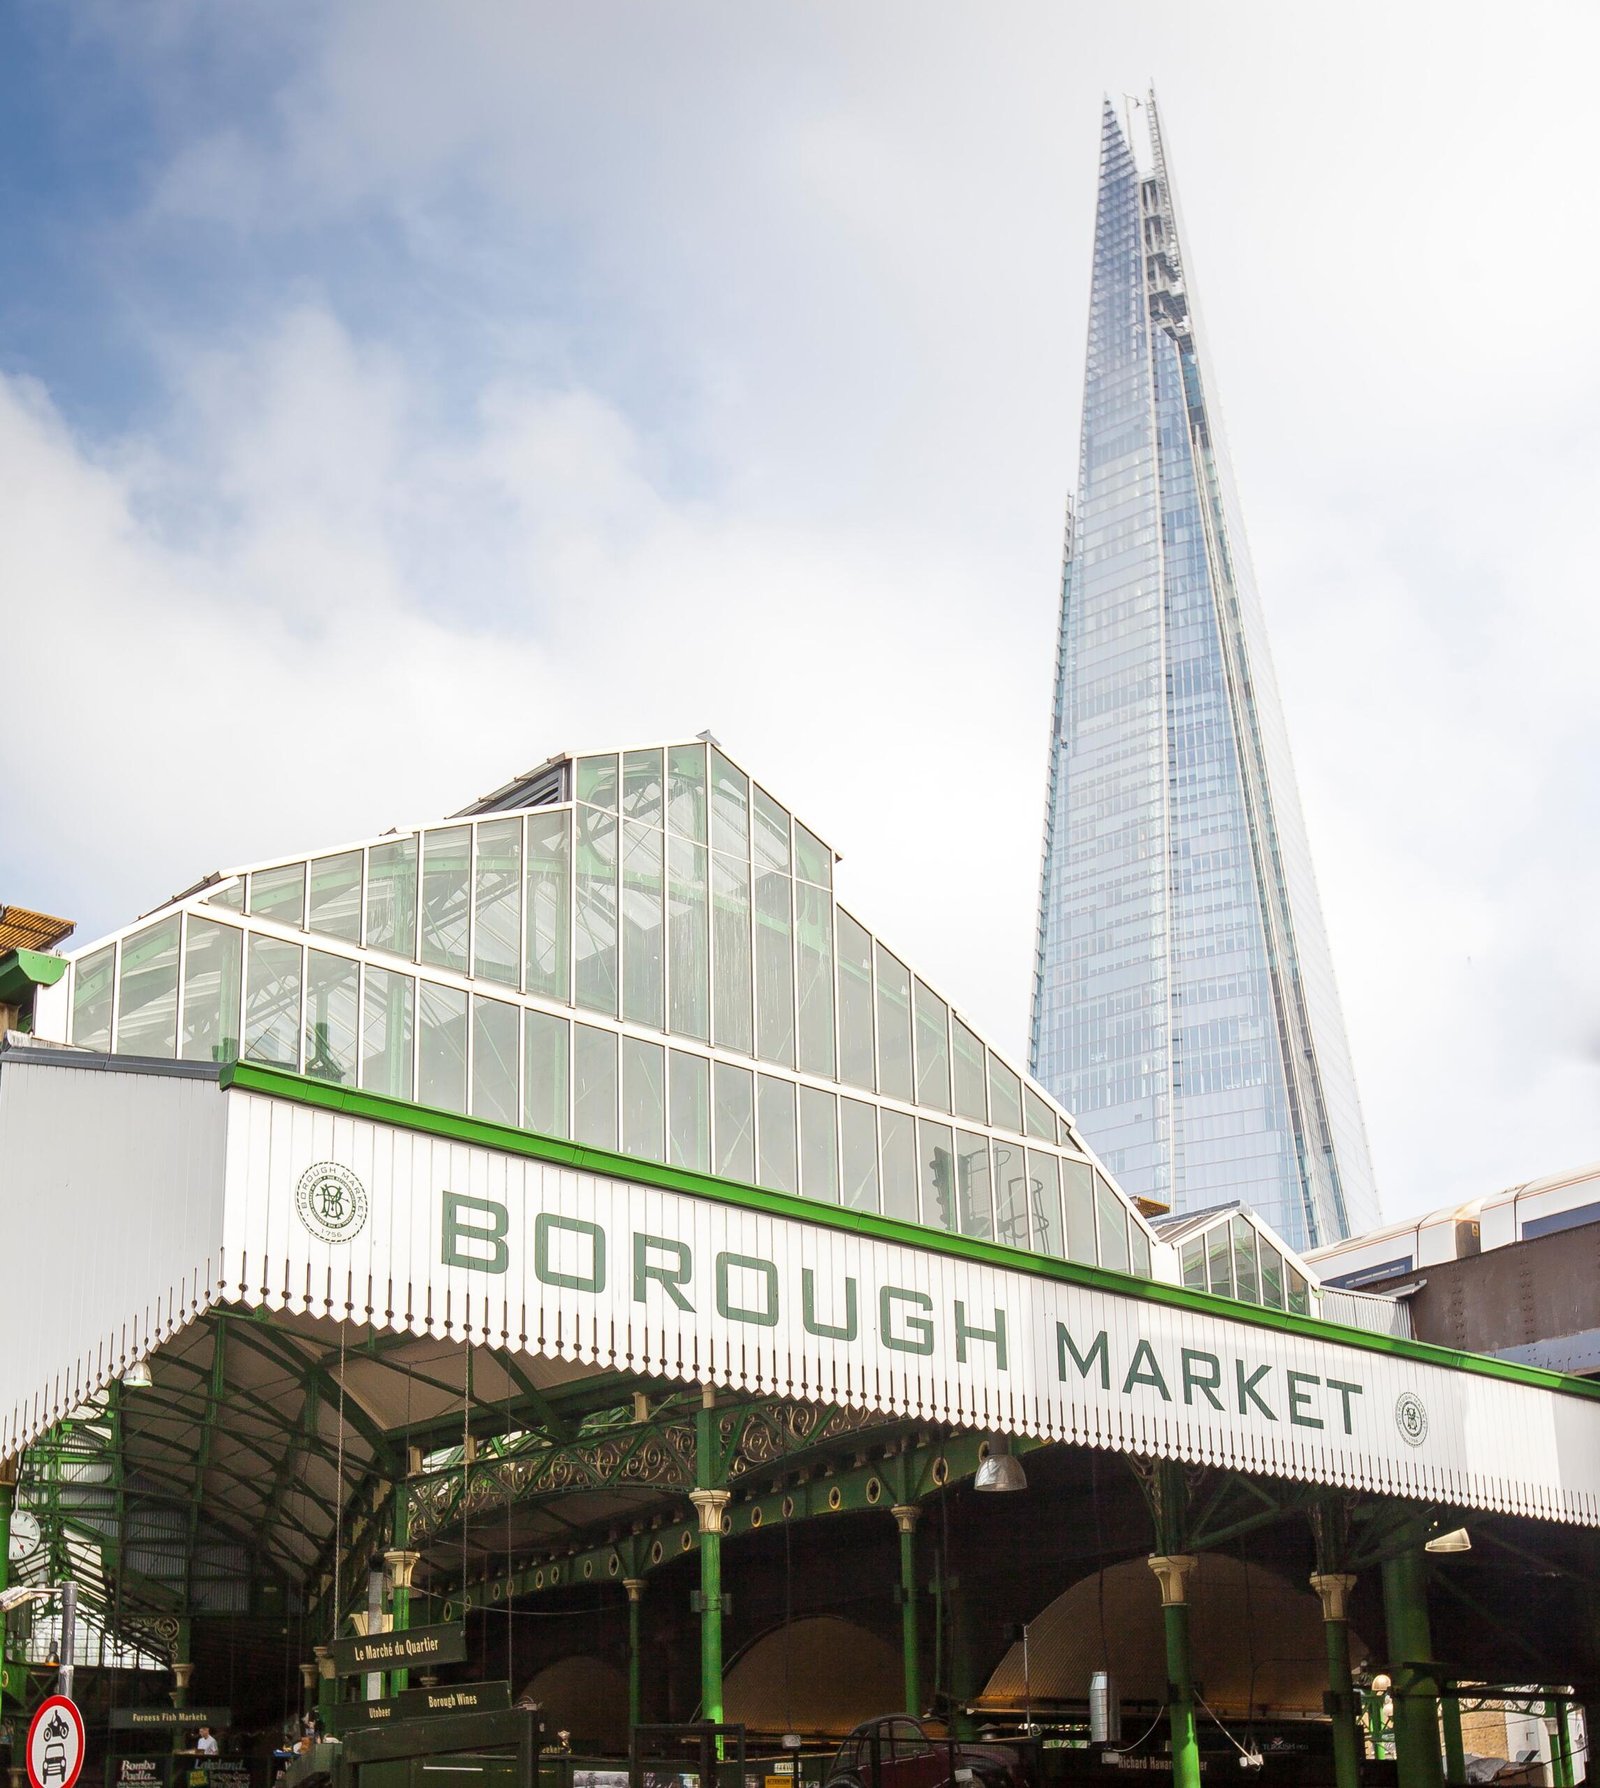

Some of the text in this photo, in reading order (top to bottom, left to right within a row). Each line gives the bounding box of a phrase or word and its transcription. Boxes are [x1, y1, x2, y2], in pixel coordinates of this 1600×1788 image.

[300, 1166, 337, 1210] BOROUGH
[341, 1171, 364, 1221] MARKET
[320, 1227, 343, 1238] 1756
[441, 1190, 1364, 1435] BOROUGH MARKET
[354, 1637, 439, 1661] Le Marché du Quartier
[428, 1692, 478, 1709] Borough Wines
[132, 1712, 207, 1722] Furness Fish Markets
[368, 1706, 391, 1719] Utobeer
[121, 1759, 156, 1771] Bomba
[1118, 1755, 1174, 1770] Richard Hawar
